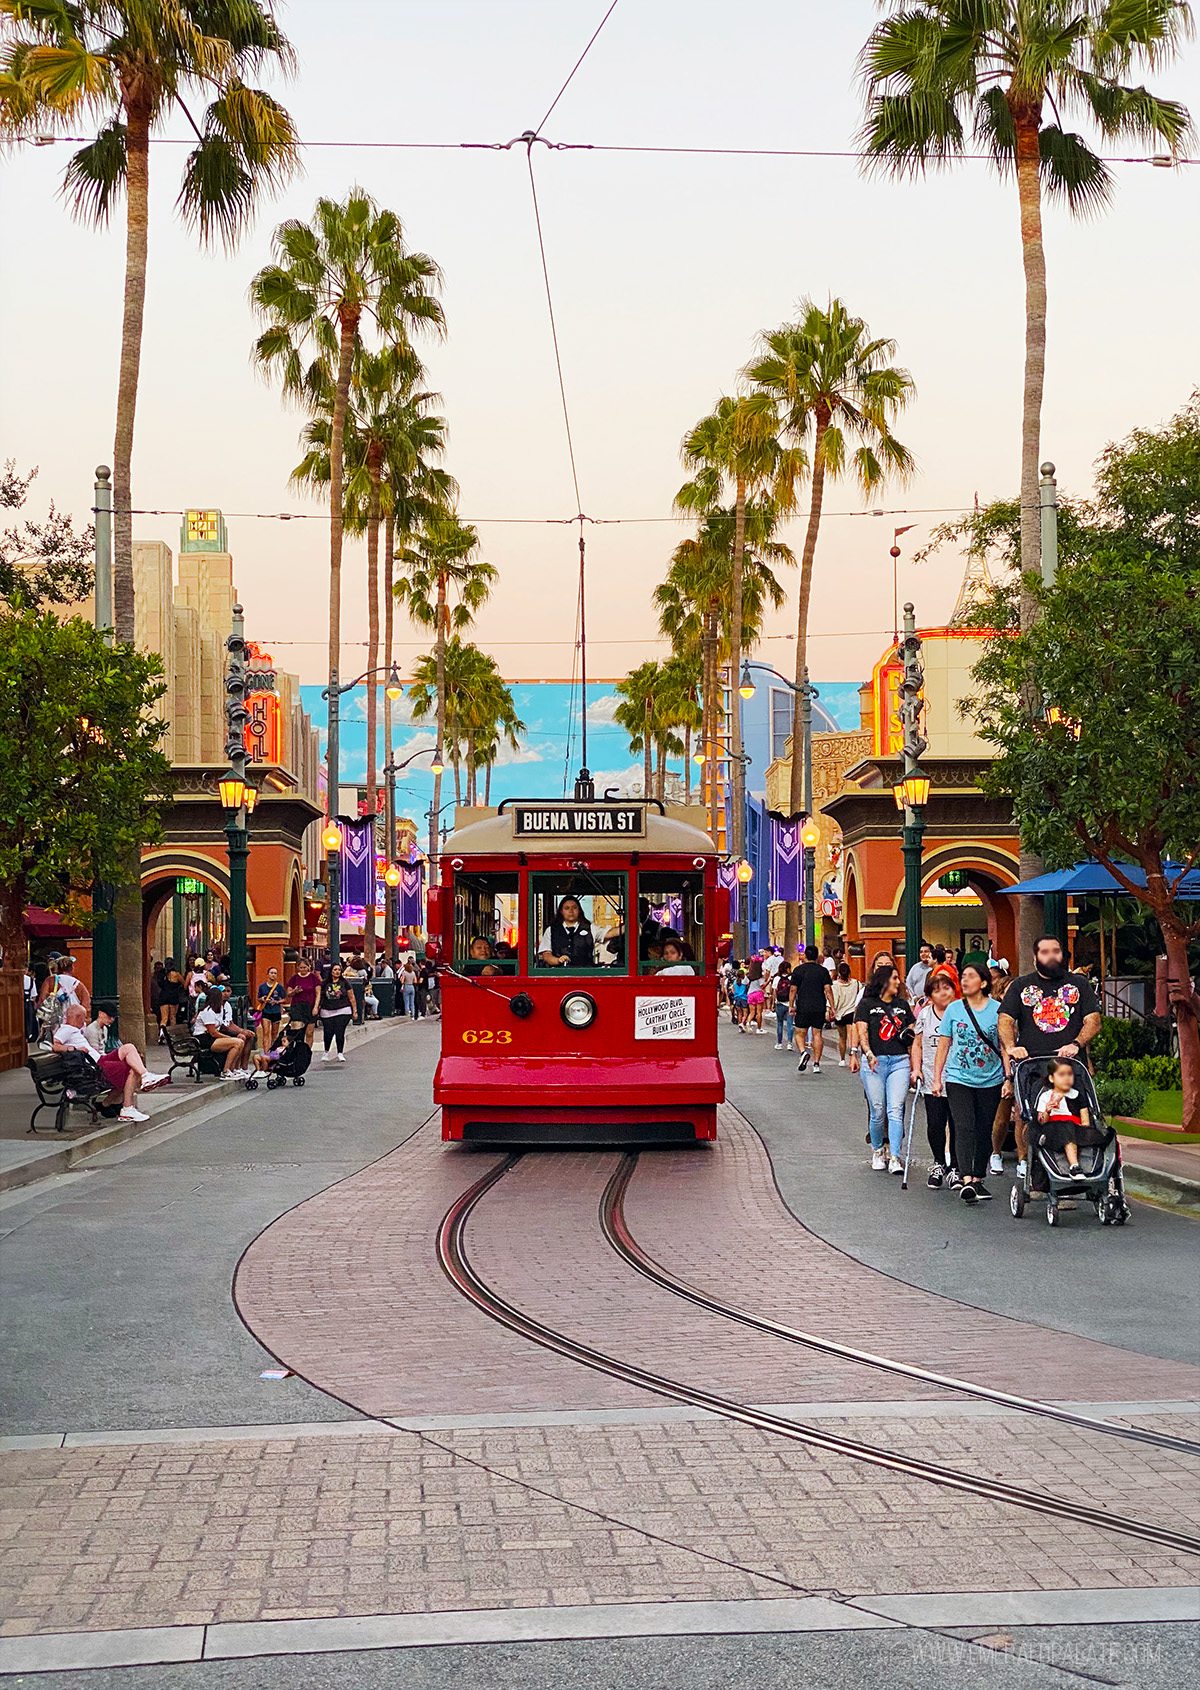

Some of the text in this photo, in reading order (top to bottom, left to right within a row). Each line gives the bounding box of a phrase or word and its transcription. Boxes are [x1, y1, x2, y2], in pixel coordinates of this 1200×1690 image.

[523, 812, 635, 830] BUENA VISTA ST
[637, 1002, 669, 1017] HOLLYWOOD
[645, 1008, 686, 1026] CARTHAY CIRCLE
[652, 1024, 668, 1035] BUENA
[670, 1020, 684, 1030] VISTA
[462, 1029, 513, 1045] 623
